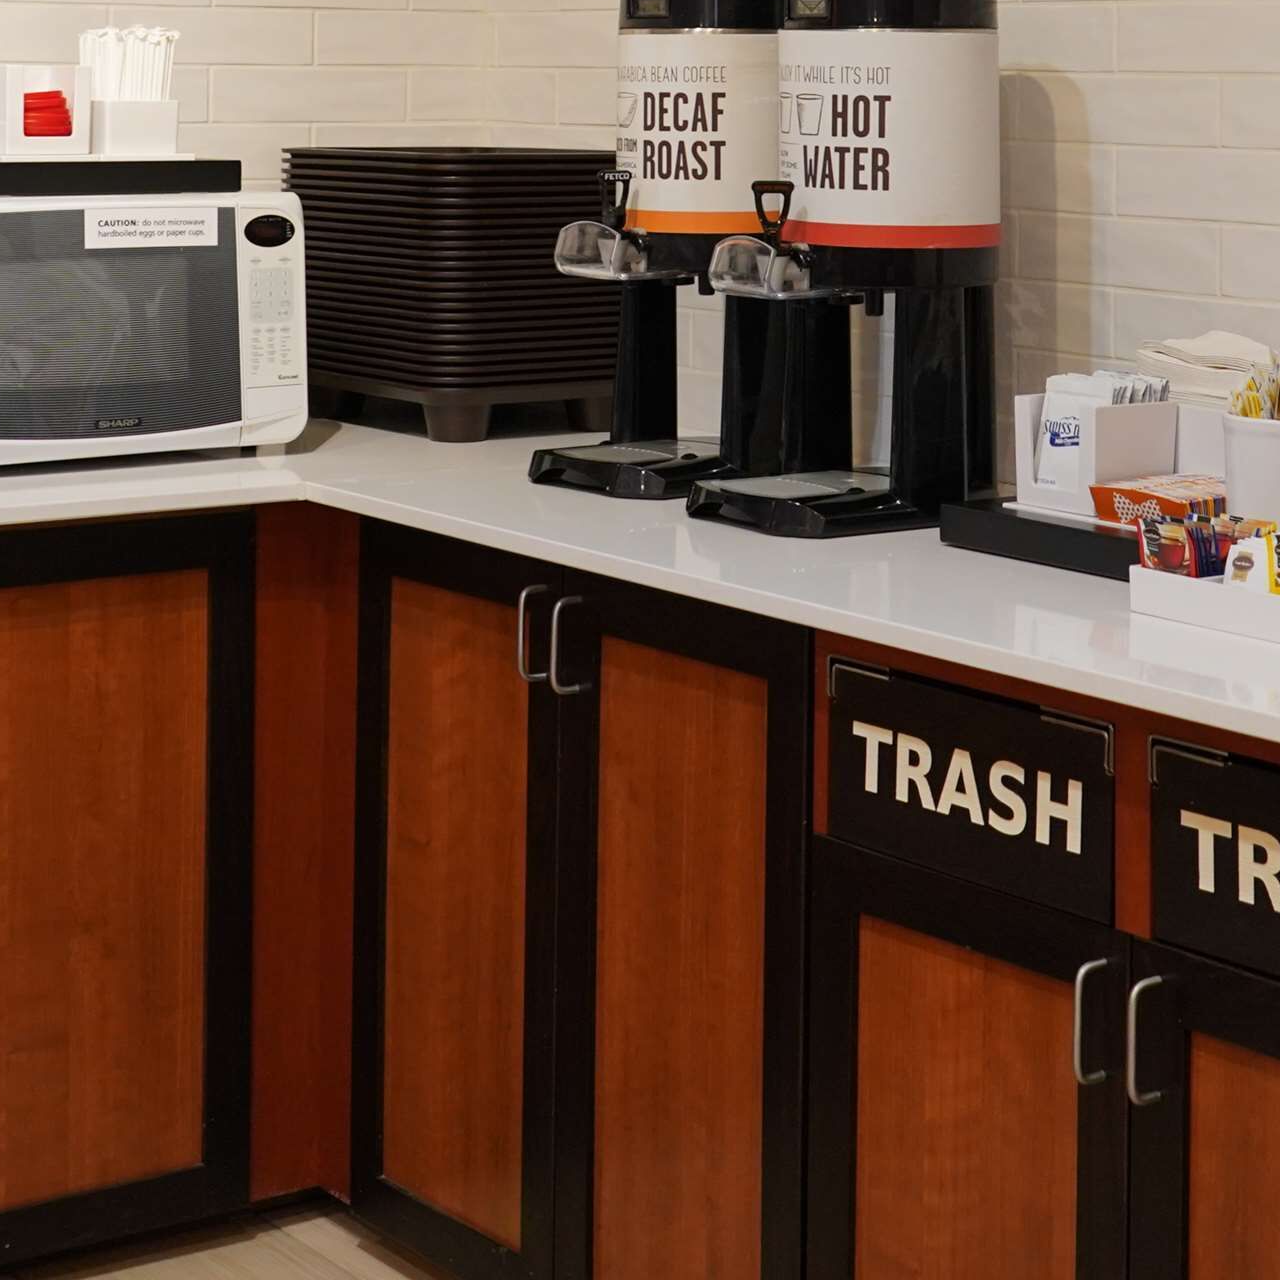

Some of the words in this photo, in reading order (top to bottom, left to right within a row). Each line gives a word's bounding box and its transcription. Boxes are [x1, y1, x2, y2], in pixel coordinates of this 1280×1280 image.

[650, 66, 678, 82] BEAN
[682, 66, 727, 83] COFFEE
[802, 65, 835, 84] WHILE
[840, 66, 861, 85] IT'S
[867, 67, 891, 85] HOT
[643, 92, 726, 132] DECAF
[831, 94, 891, 138] HOT
[643, 140, 726, 180] ROAST
[803, 144, 890, 191] WATER
[604, 172, 630, 181] FETCO
[97, 219, 140, 228] CAUTION:
[142, 218, 152, 226] do
[167, 217, 206, 226] microwave
[97, 229, 137, 238] hardboiled
[139, 229, 156, 238] eggs
[166, 229, 187, 238] paper
[98, 419, 139, 429] SHARP
[852, 720, 1083, 855] TRASH
